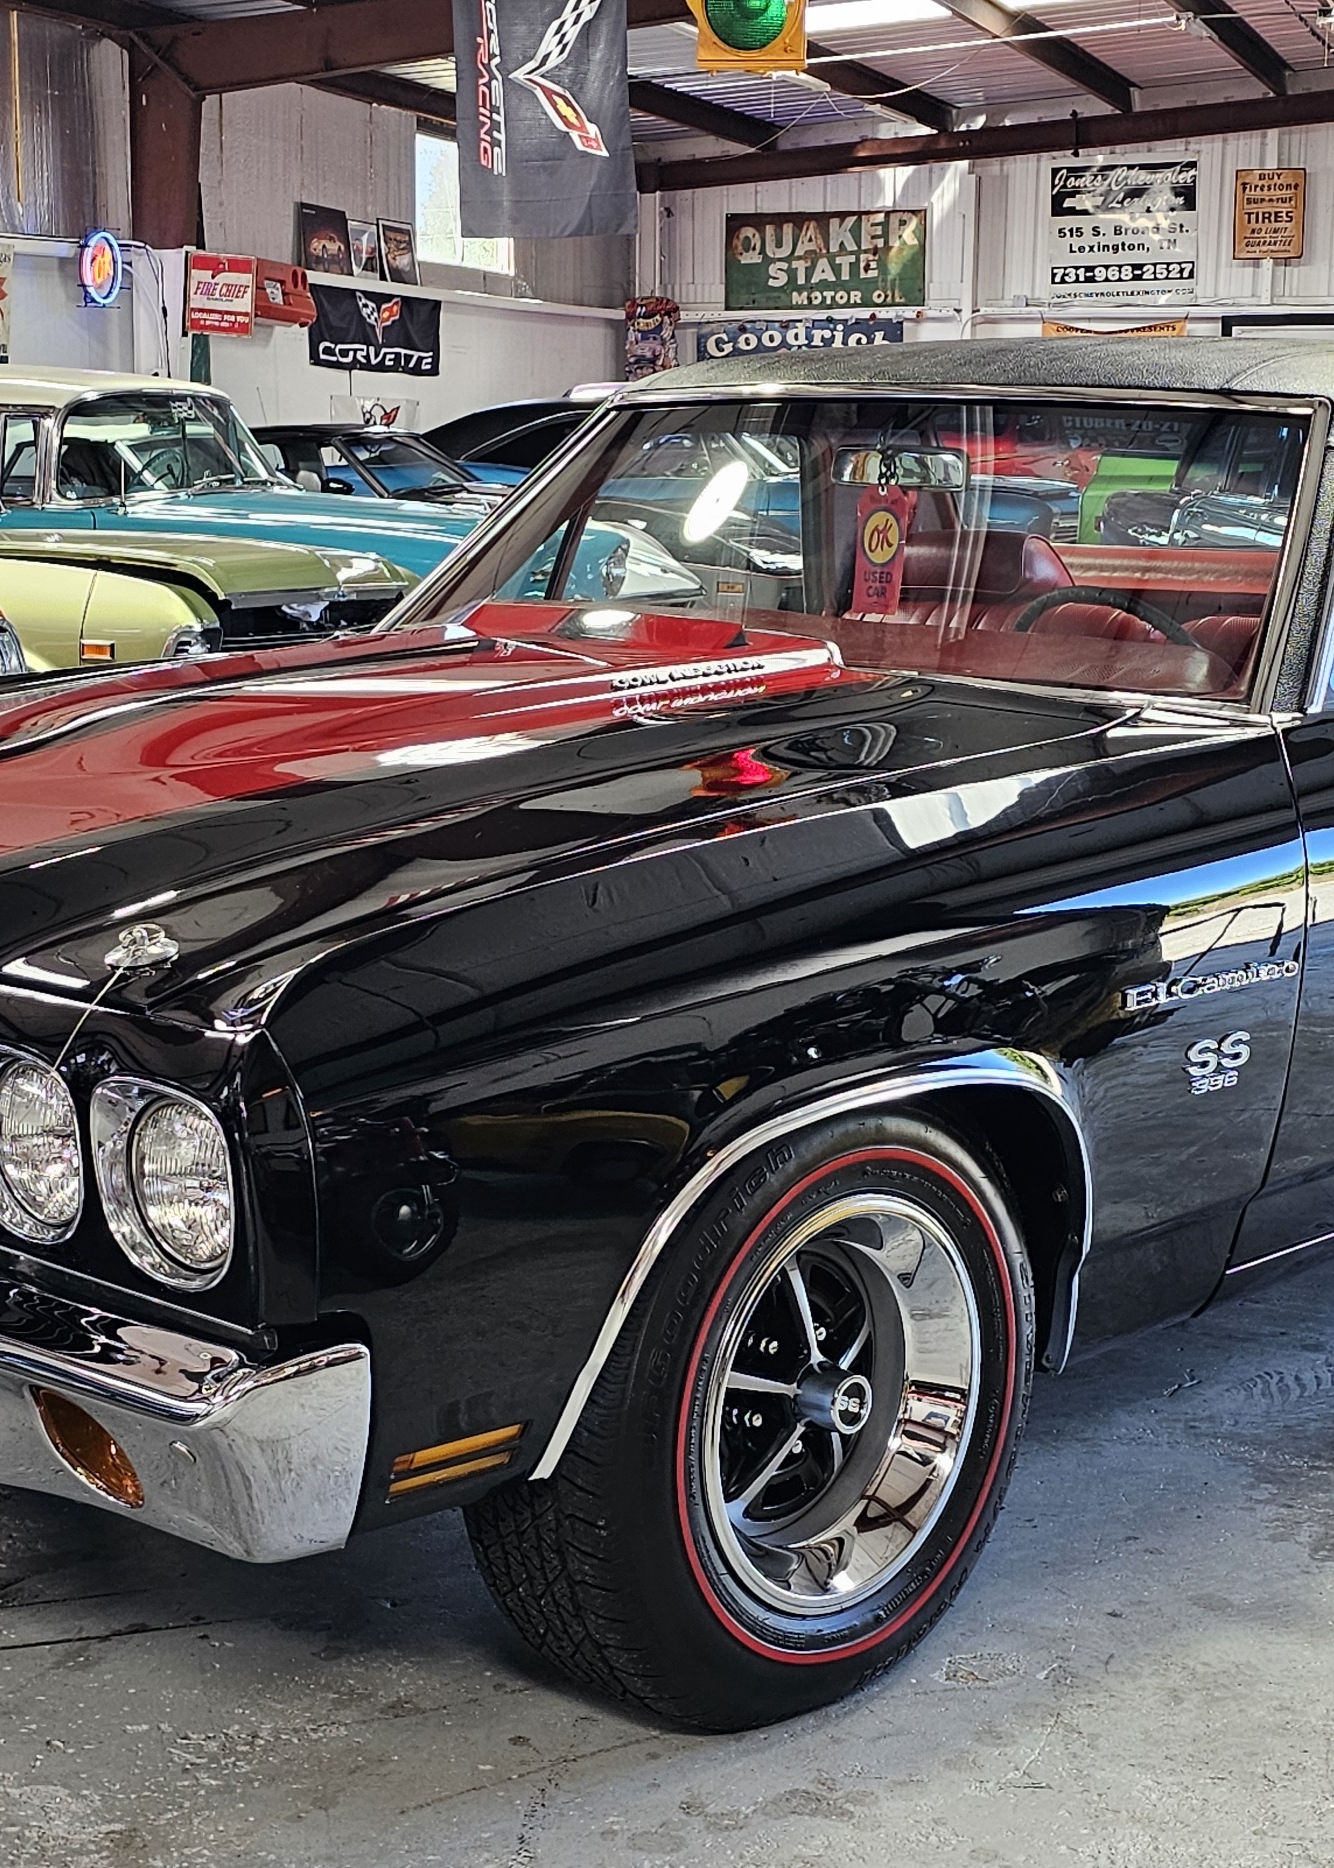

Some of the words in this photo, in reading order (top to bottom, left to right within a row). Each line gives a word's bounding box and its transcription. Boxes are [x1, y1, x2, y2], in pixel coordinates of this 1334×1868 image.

[476, 0, 492, 169] RACING
[485, 0, 506, 176] ORVETTE
[1052, 168, 1105, 195] Jones
[1258, 172, 1283, 181] BUY
[1240, 181, 1299, 194] Firestone
[1243, 210, 1294, 224] TIRES
[732, 212, 919, 264] QUAKER
[1058, 227, 1084, 239] 515
[1091, 226, 1106, 237] S.
[1167, 223, 1190, 234] St.
[1250, 227, 1263, 235] NO
[1264, 226, 1289, 235] LIMIT
[1069, 240, 1150, 254] Lexington,
[767, 253, 879, 288] STATE
[1052, 263, 1193, 283] 731-968-2527
[193, 281, 219, 297] FIRE
[219, 282, 250, 299] CHIEF
[791, 291, 862, 305] MOTOR
[872, 289, 906, 304] OIL
[318, 341, 434, 370] CORVETTE
[868, 518, 894, 554] OK
[863, 571, 893, 584] USED
[866, 585, 888, 598] CAR
[1183, 1030, 1251, 1077] SS
